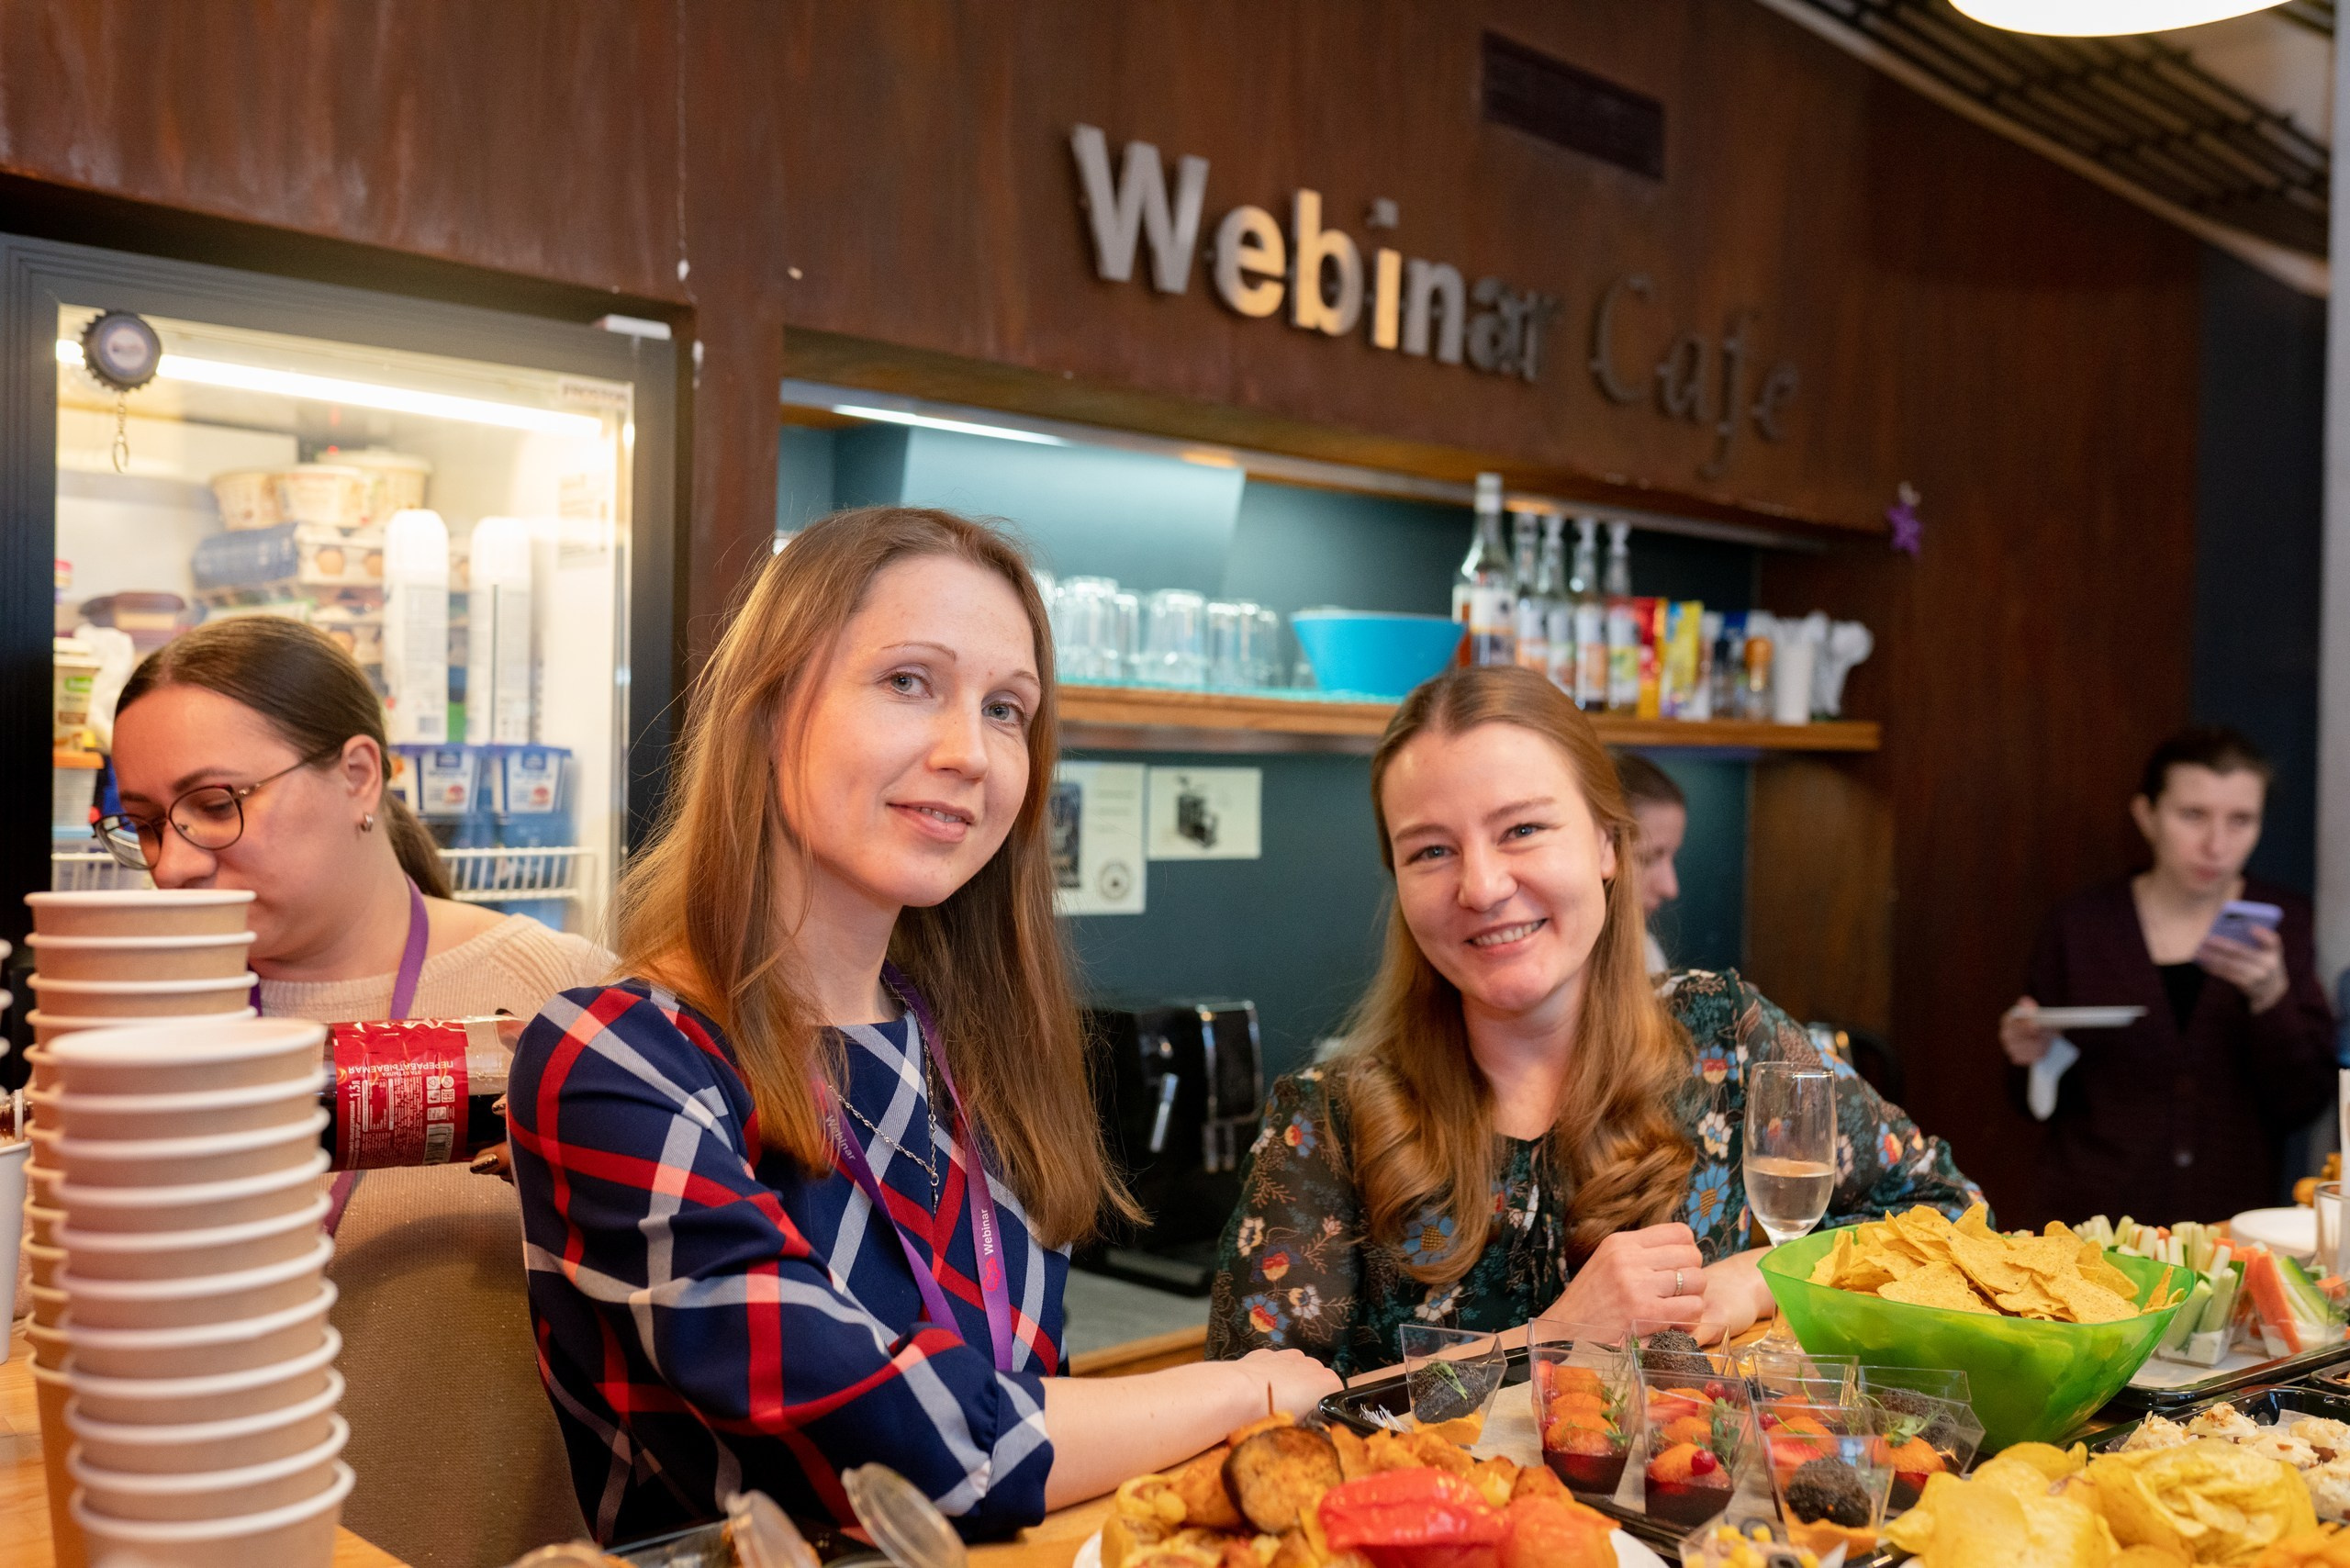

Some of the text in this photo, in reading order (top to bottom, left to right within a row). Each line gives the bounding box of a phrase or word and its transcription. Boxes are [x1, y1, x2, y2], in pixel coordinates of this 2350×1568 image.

[1071, 123, 1797, 480] Webinar Cafe
[348, 1060, 453, 1074] ПЕРЕРАБАТЫВАЕМАЯ
[826, 1114, 856, 1160] Webinar
[981, 1208, 994, 1256] Webinar
